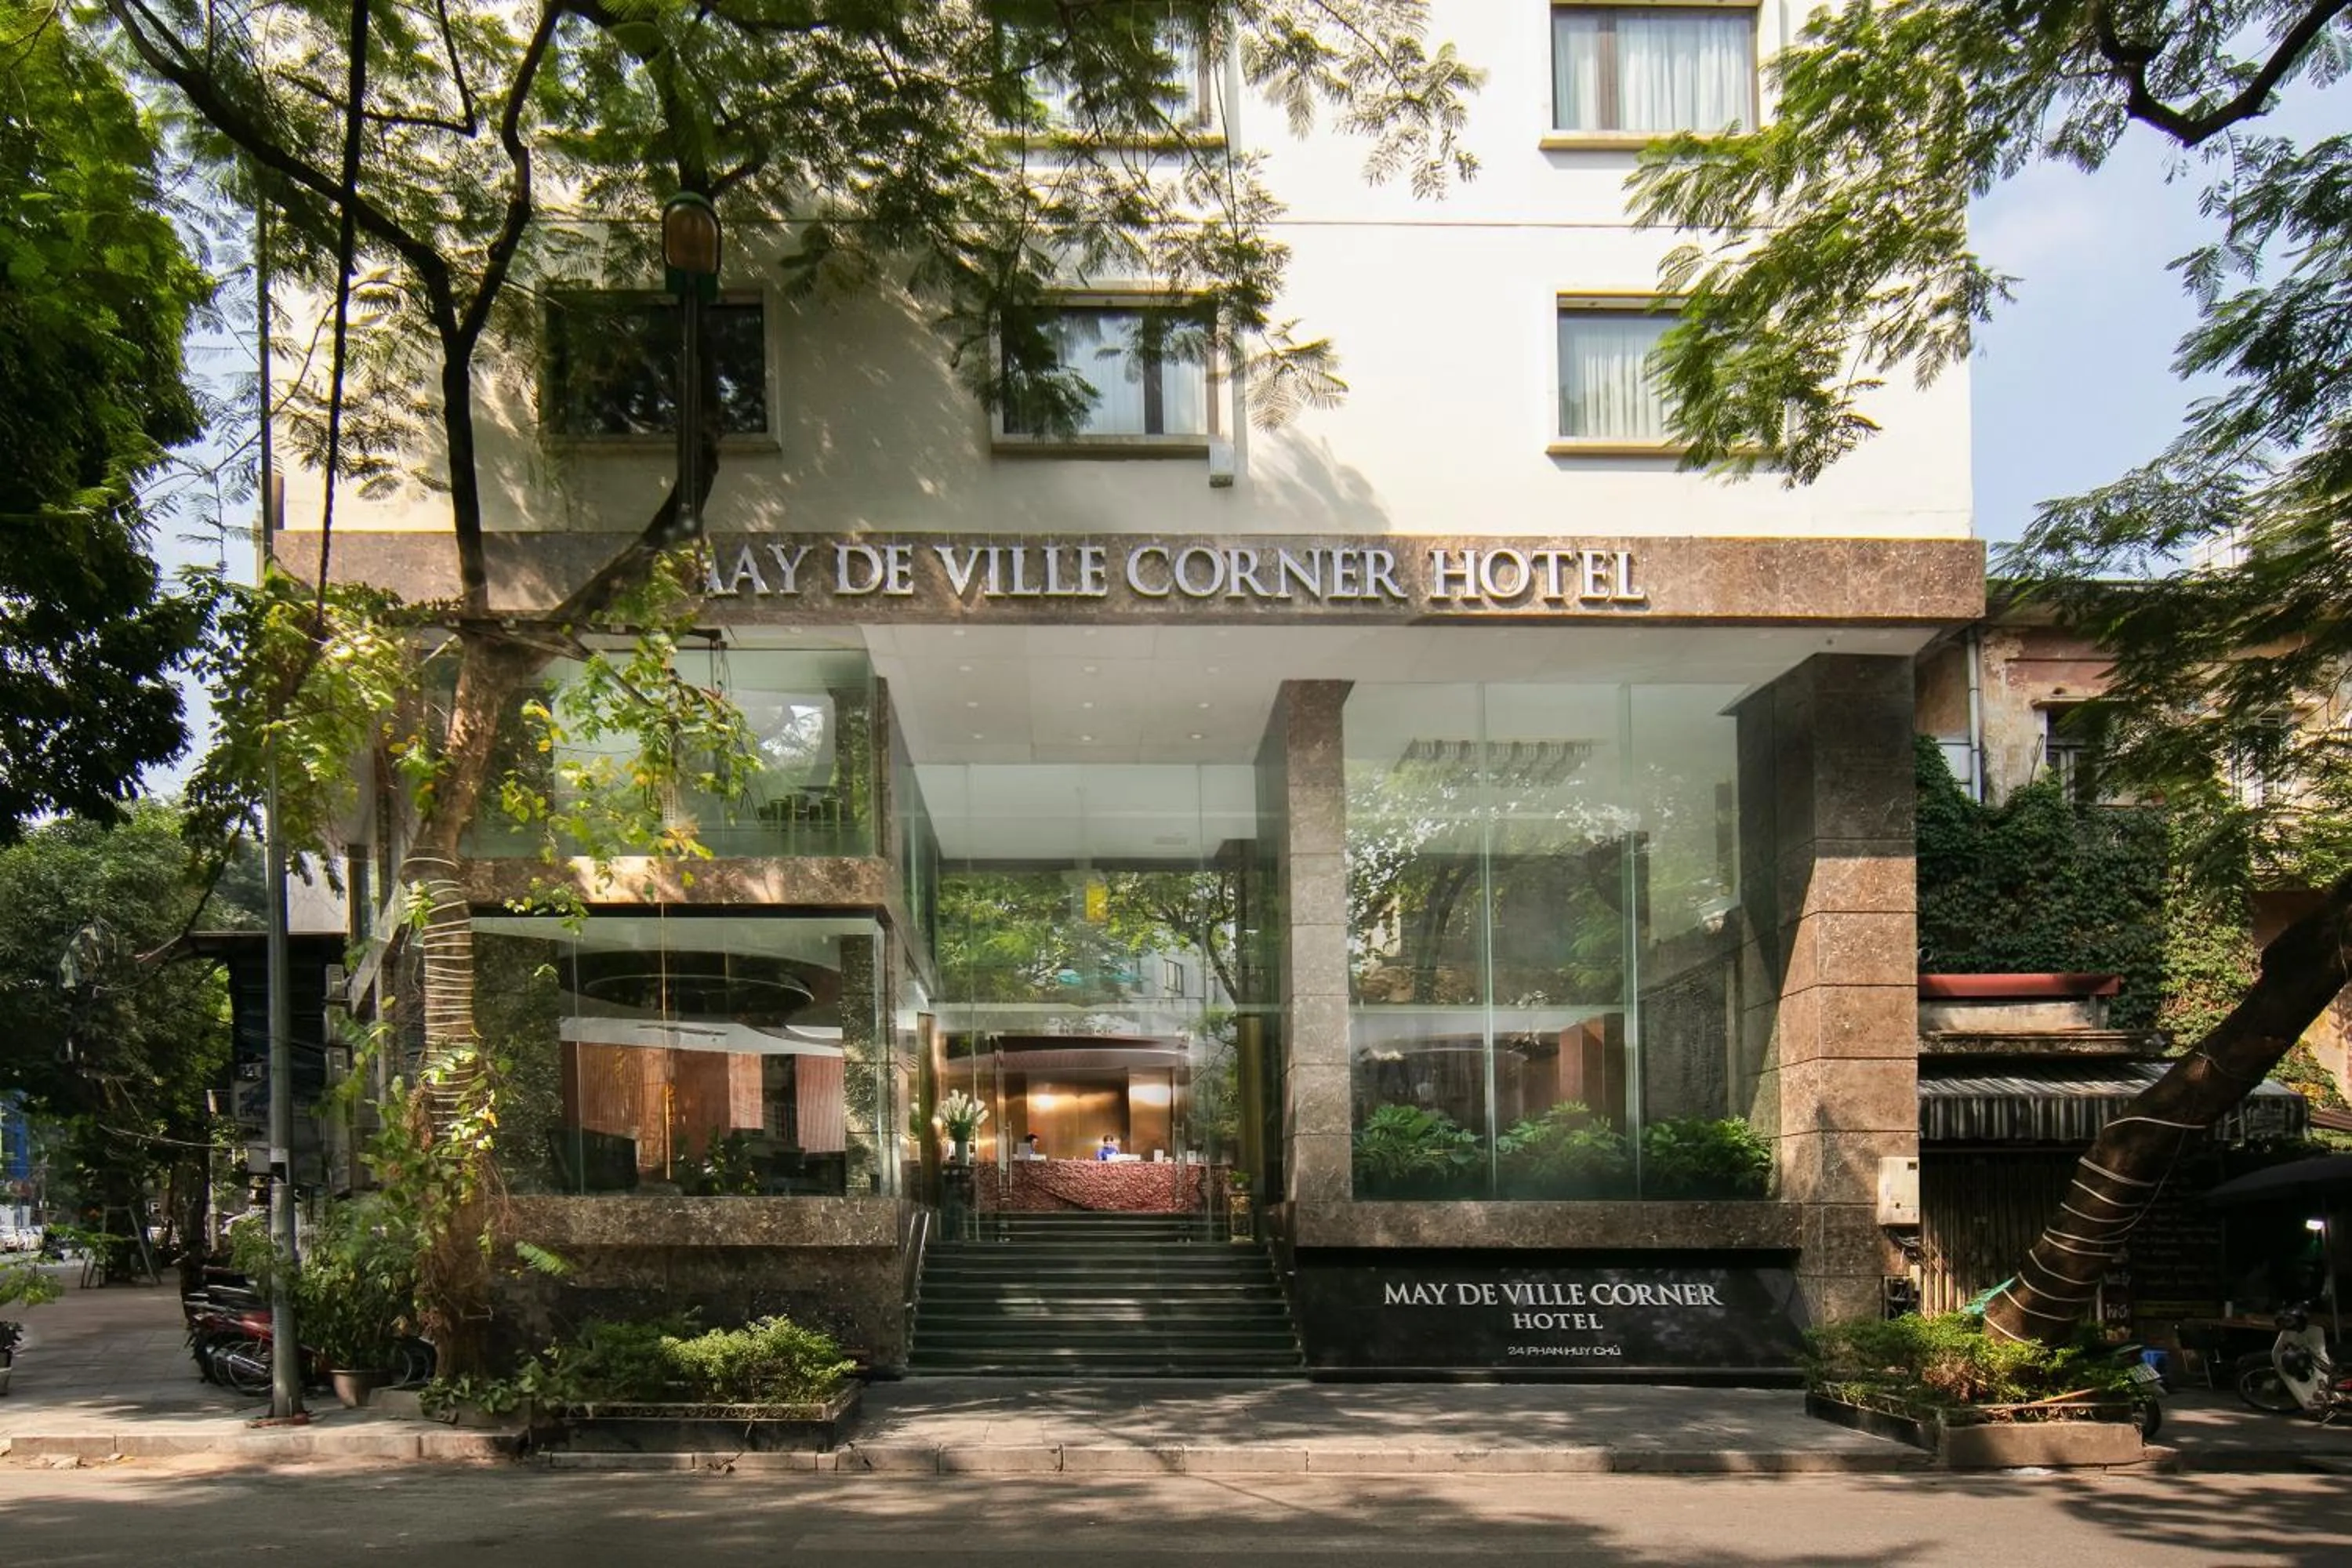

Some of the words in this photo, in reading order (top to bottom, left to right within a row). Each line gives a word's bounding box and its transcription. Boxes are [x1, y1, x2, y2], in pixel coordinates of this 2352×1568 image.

[833, 543, 914, 596] DE
[934, 544, 1107, 597] VILLE
[1126, 546, 1407, 599] CORNER
[1429, 548, 1646, 601] HOTEL
[1384, 1283, 1450, 1306] MAY
[1457, 1283, 1498, 1305] DE
[1501, 1283, 1586, 1306] VILLE
[1590, 1283, 1723, 1306] CORNER
[1512, 1312, 1603, 1330] HOTEL
[1507, 1346, 1525, 1356] 24
[1528, 1346, 1564, 1356] PHAN
[1564, 1346, 1590, 1356] HUY
